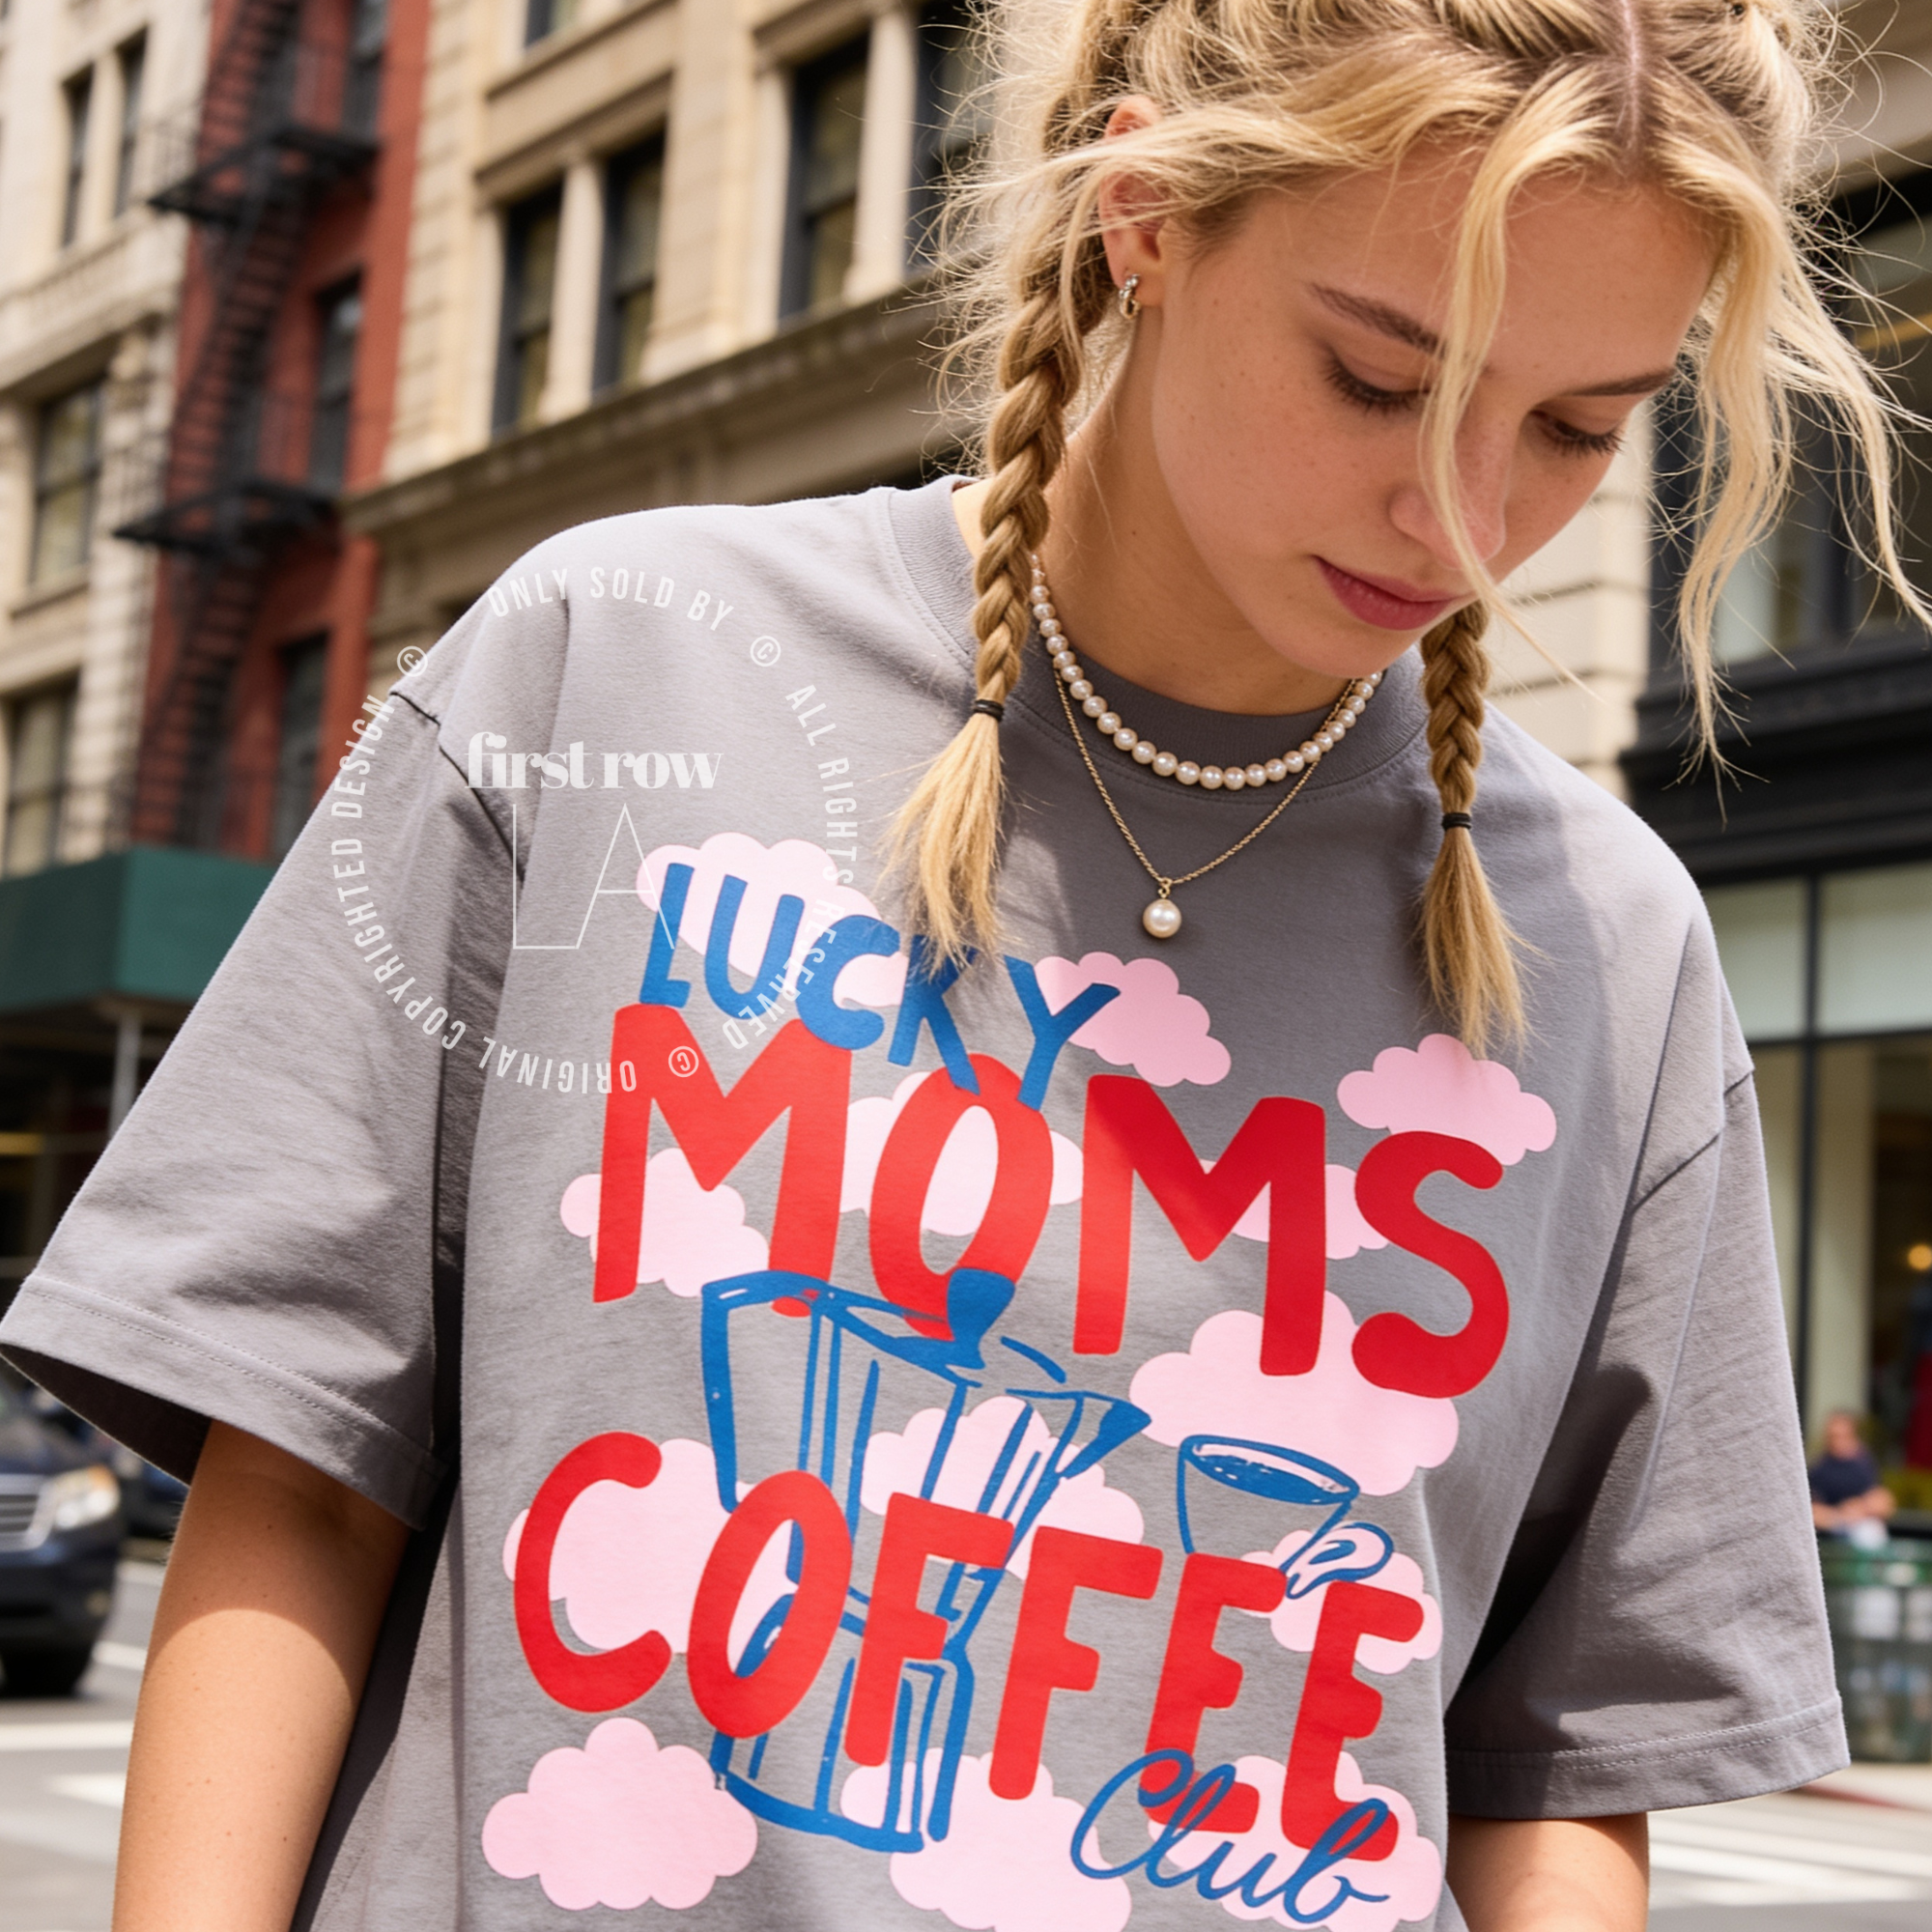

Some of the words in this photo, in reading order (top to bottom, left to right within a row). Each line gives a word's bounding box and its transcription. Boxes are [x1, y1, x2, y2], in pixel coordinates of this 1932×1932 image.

[639, 863, 1121, 1111] LUCKY
[593, 1003, 1510, 1398] MOMS
[513, 1432, 1424, 1861] COFFEE
[1070, 1748, 1391, 1923] Club
